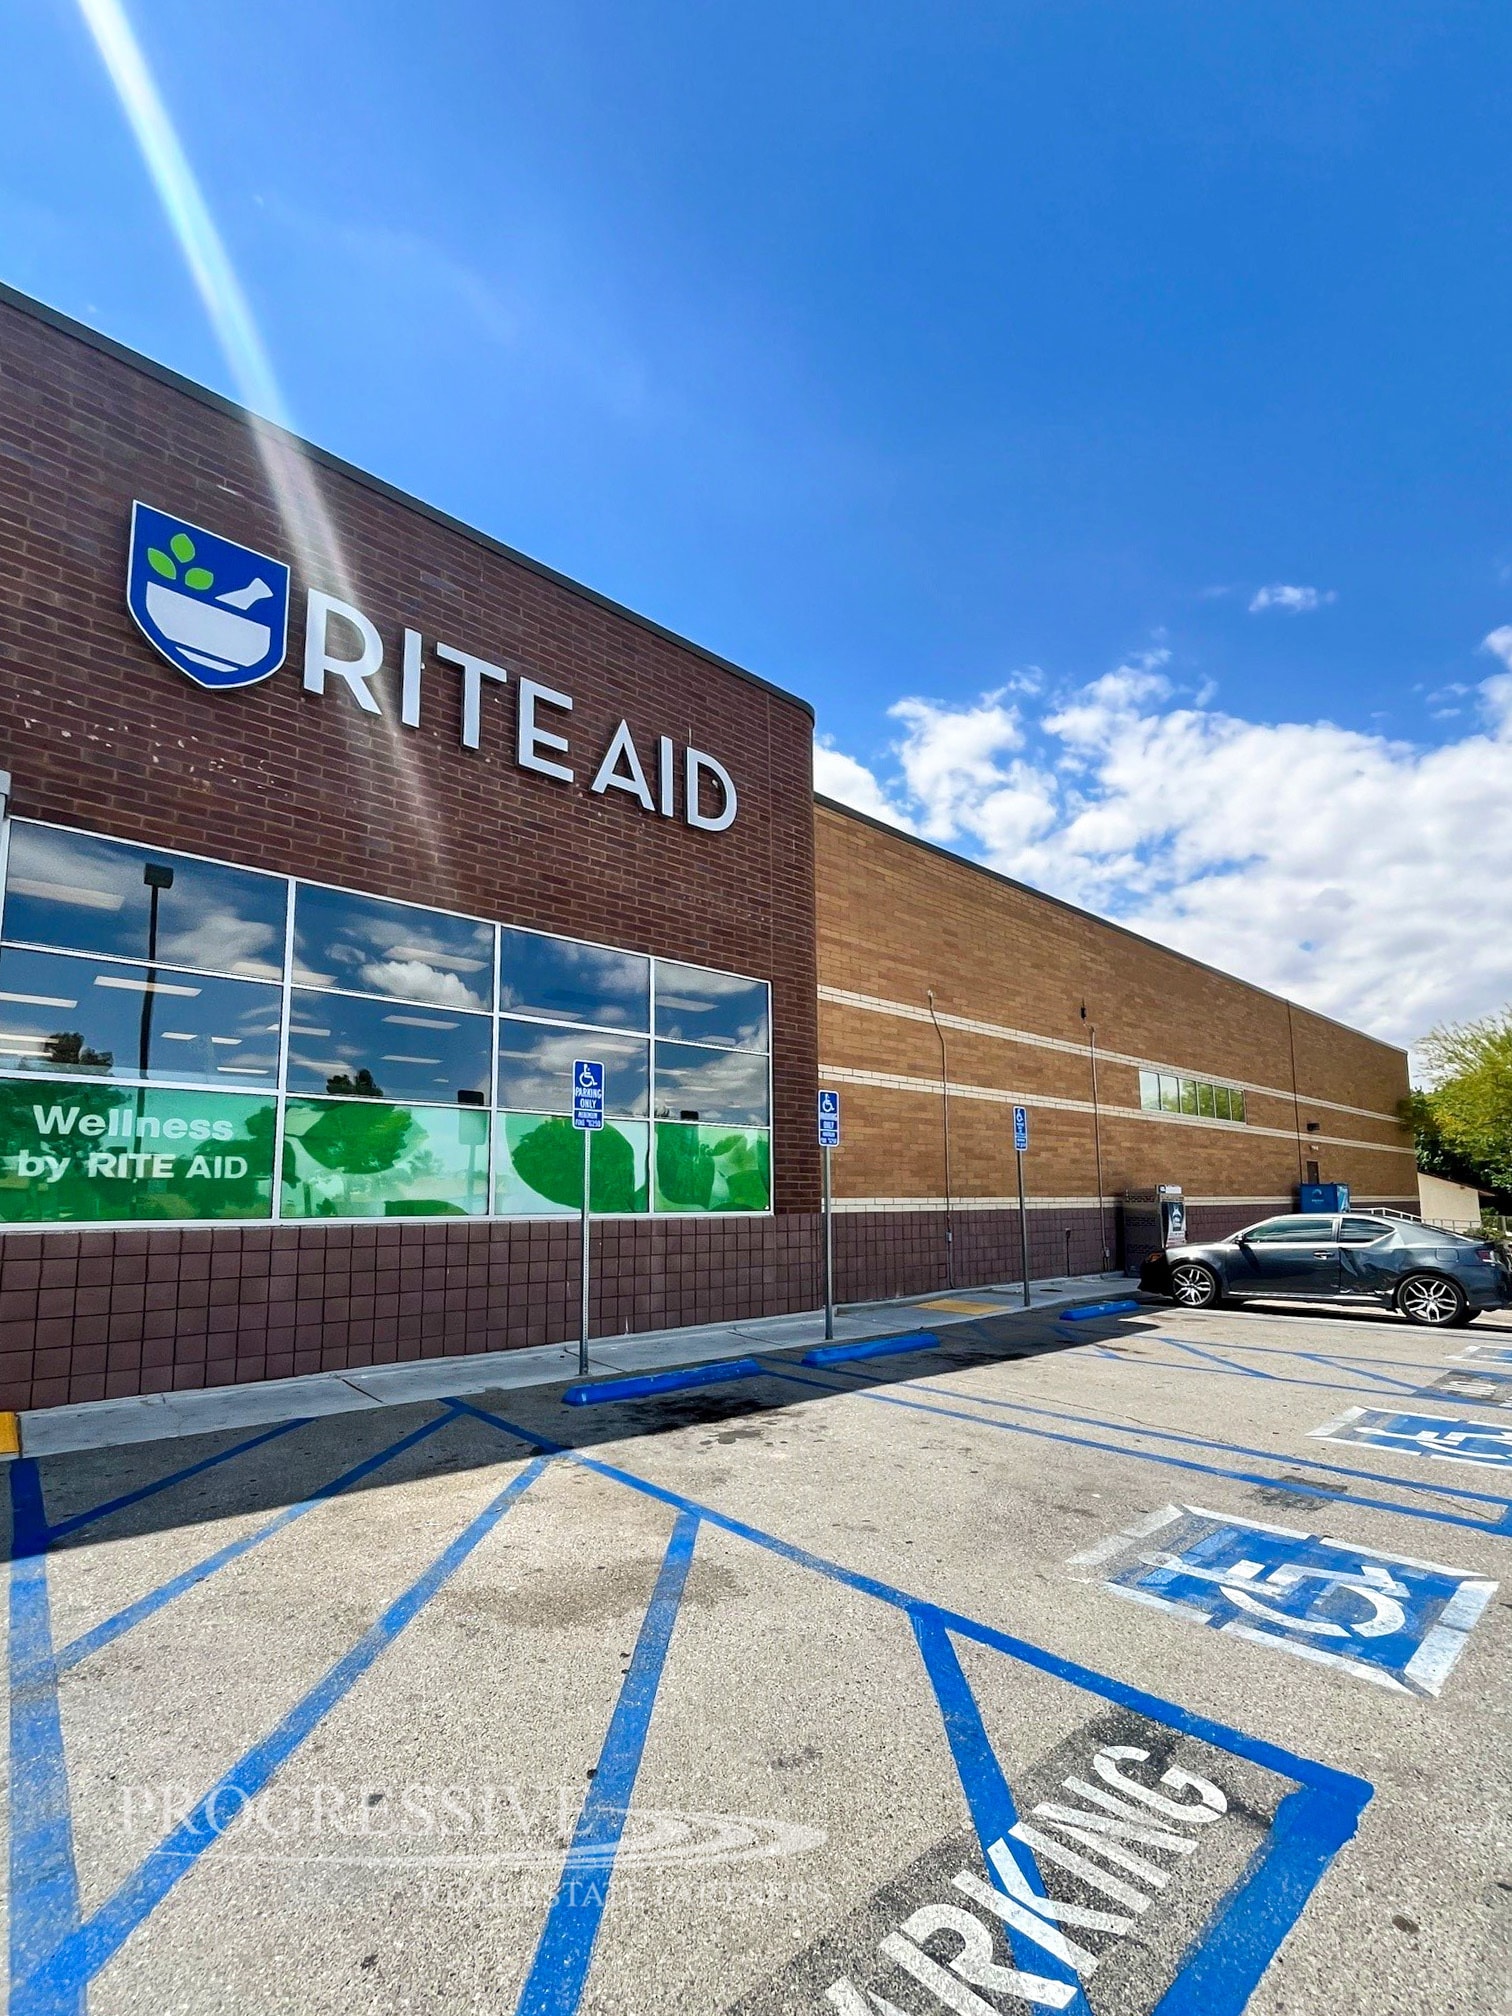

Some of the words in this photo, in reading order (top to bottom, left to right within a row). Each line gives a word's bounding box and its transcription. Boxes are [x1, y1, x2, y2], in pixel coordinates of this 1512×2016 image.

[303, 588, 575, 784] RITE
[590, 718, 738, 832] AID
[575, 1087, 602, 1099] PARKING
[580, 1098, 597, 1109] ONLY
[33, 1104, 234, 1140] Wellness
[18, 1150, 70, 1184] by
[88, 1152, 176, 1179] RITE
[185, 1154, 248, 1179] AID
